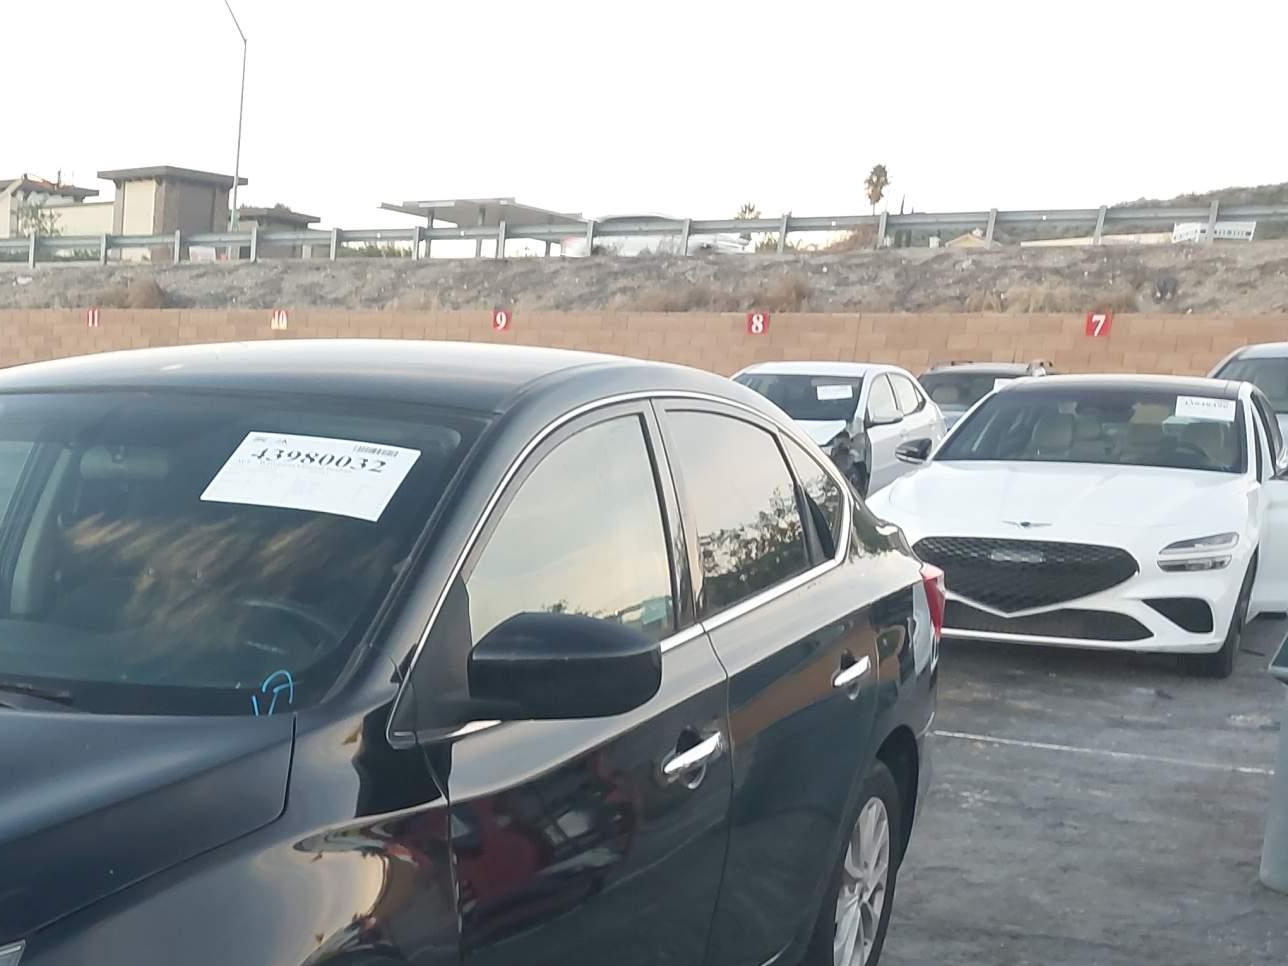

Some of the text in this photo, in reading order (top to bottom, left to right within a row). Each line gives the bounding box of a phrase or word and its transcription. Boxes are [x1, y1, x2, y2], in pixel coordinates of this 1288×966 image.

[88, 309, 98, 327] 11
[496, 311, 507, 330] 9
[751, 313, 764, 333] 8
[1092, 315, 1106, 336] 7
[251, 447, 387, 474] 43980032
